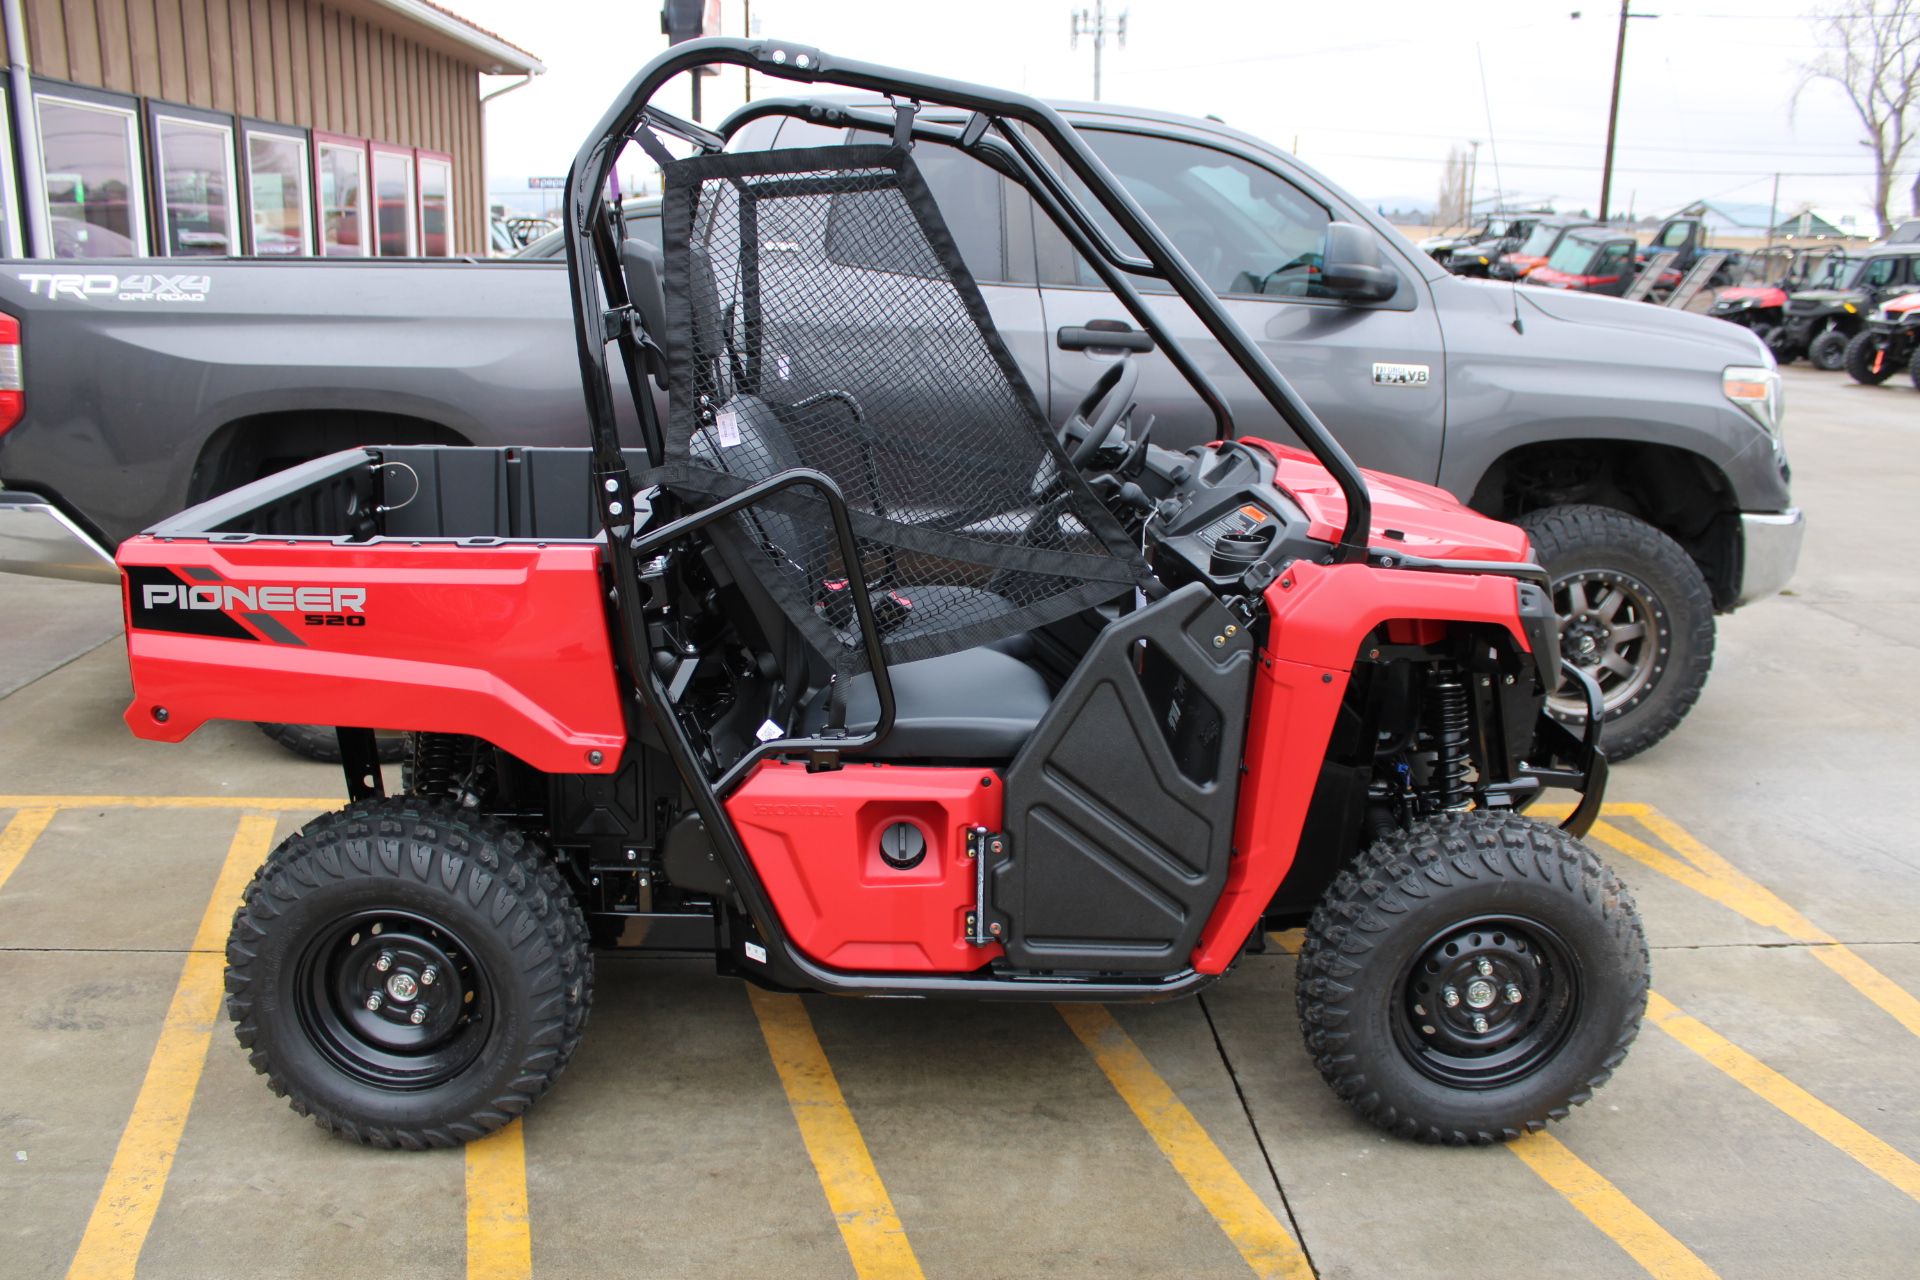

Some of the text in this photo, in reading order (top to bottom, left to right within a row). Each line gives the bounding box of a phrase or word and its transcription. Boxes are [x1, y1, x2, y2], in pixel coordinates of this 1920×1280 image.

[18, 274, 119, 300] TRD
[118, 293, 205, 302] OFF ROAD
[1408, 370, 1427, 382] V8
[143, 584, 366, 612] PIONEER
[304, 614, 366, 626] 520
[753, 802, 844, 816] HONDA
